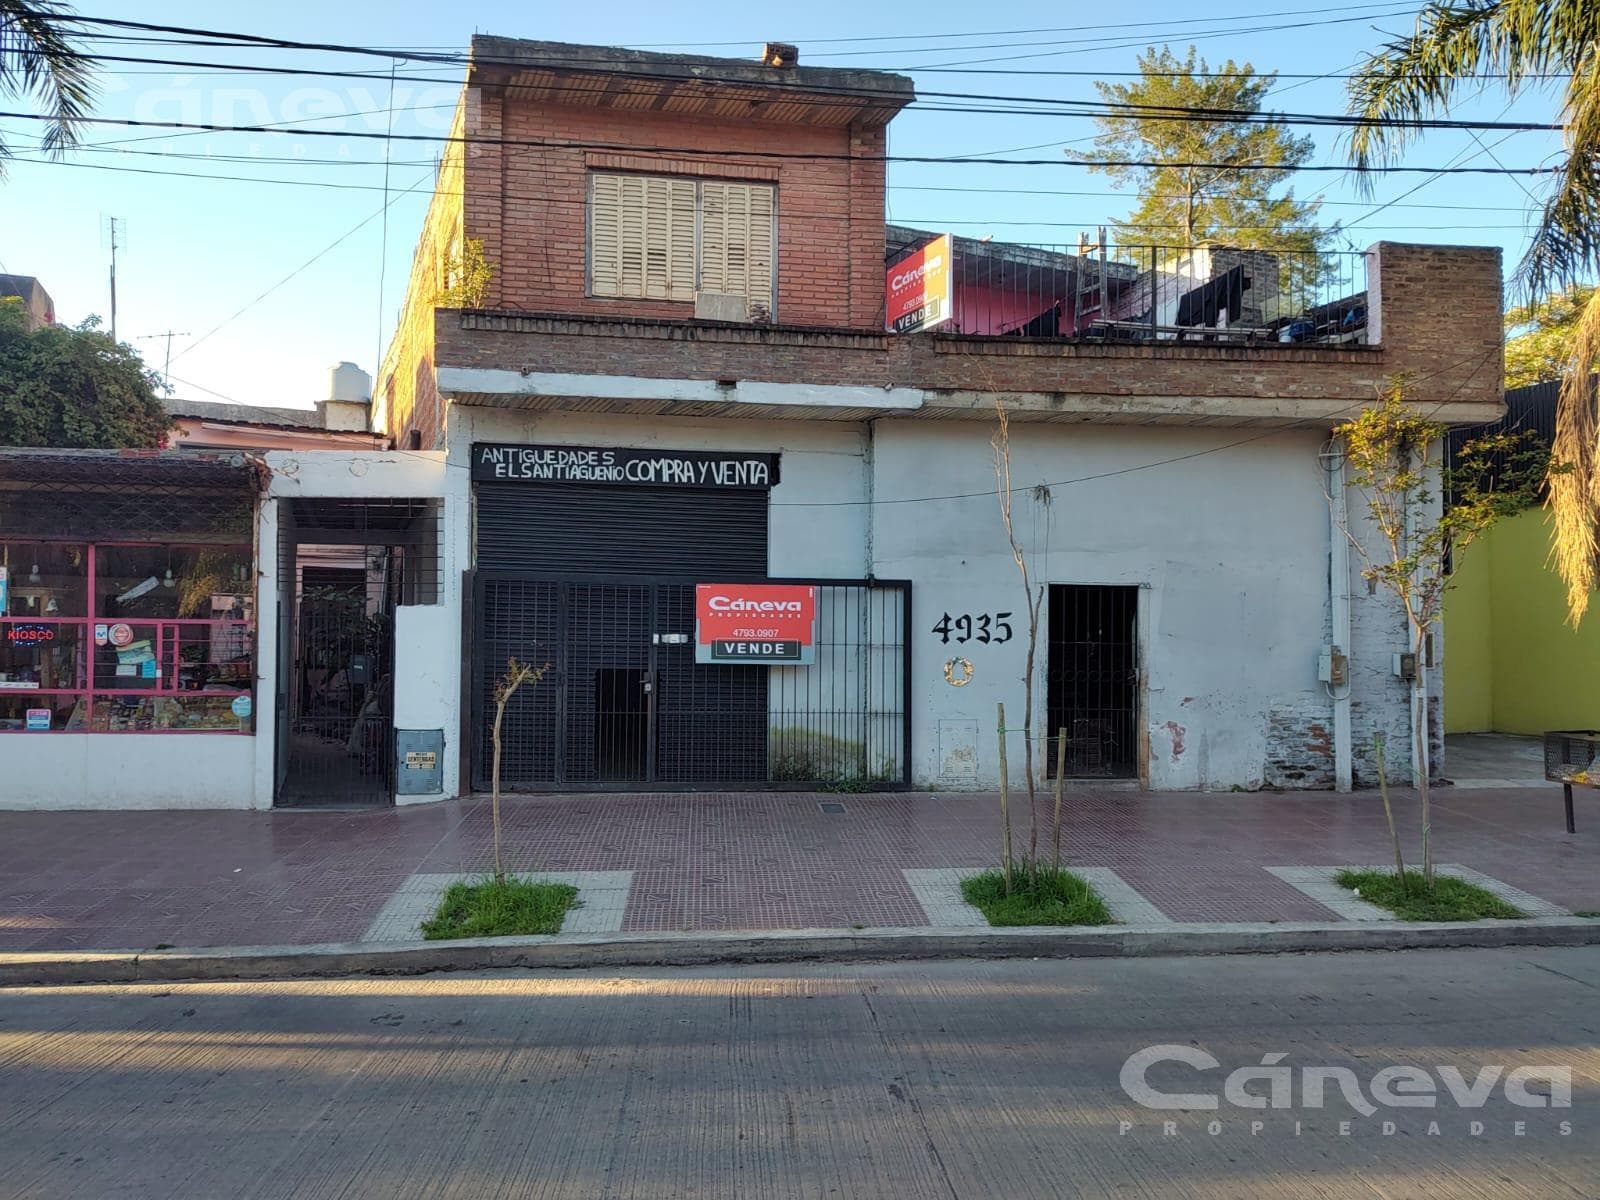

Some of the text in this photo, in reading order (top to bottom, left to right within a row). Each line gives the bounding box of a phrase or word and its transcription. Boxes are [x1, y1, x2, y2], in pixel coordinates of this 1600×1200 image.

[898, 304, 932, 330] VENDE
[625, 458, 769, 485] COMPRA Y VENTA
[708, 595, 802, 612] Cáneva
[7, 630, 54, 641] KIOSCO
[732, 628, 780, 638] 4793.0907
[931, 611, 1013, 645] 4935
[724, 643, 785, 655] VENDE
